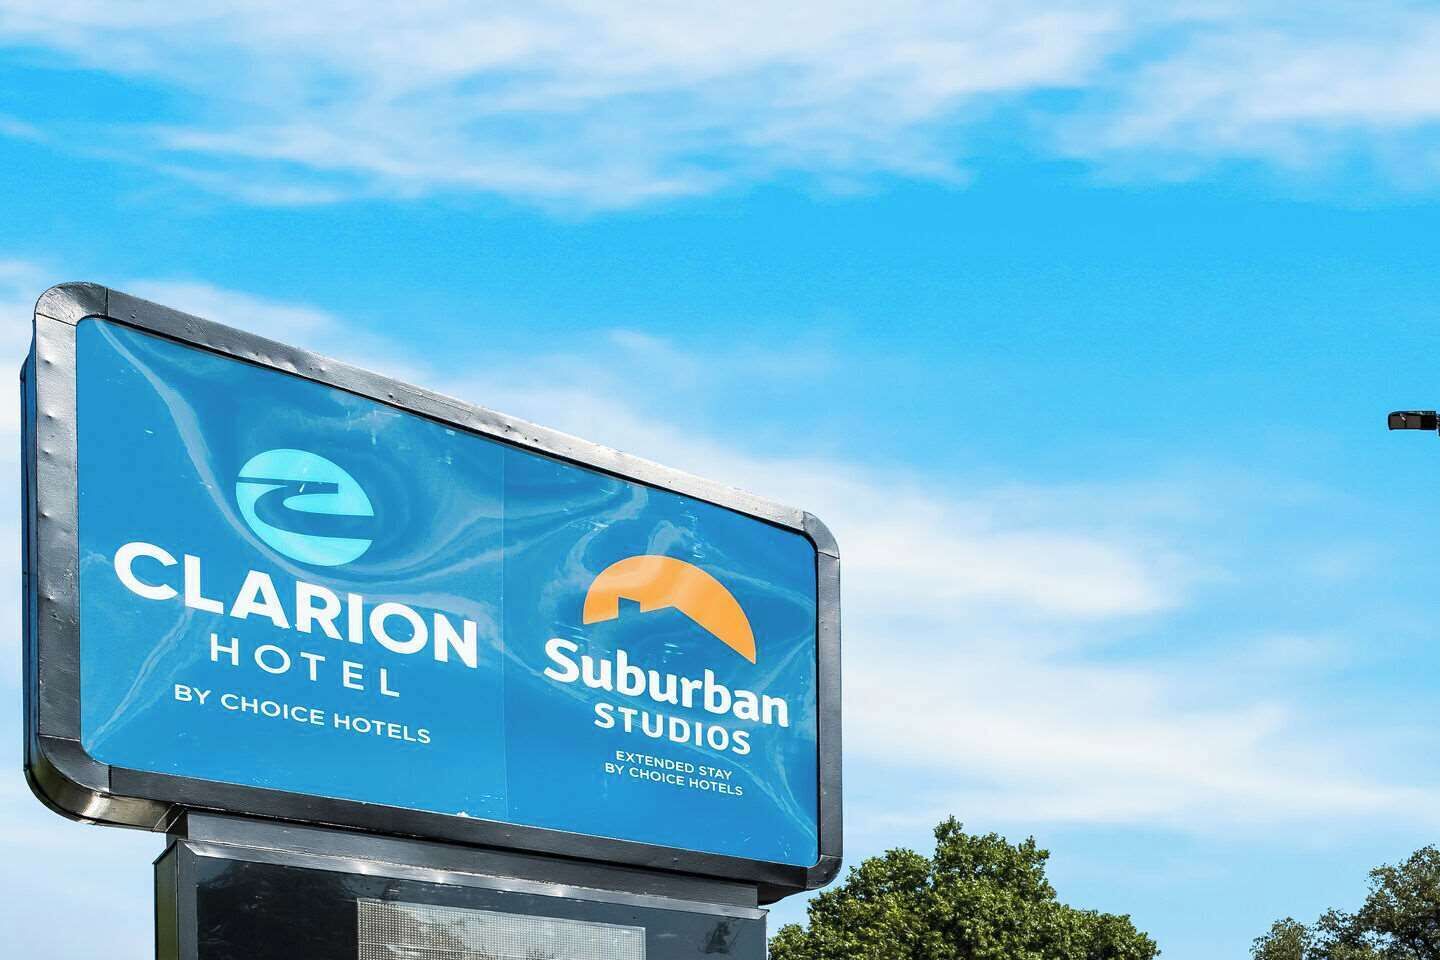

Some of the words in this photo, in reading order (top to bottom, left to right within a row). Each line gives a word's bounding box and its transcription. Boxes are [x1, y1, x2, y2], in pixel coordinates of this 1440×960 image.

[113, 541, 478, 669] CLARION
[210, 633, 400, 698] HOTEL
[543, 637, 790, 728] Suburban
[174, 684, 211, 705] BY
[220, 693, 325, 726] CHOICE
[333, 712, 431, 745] HOTELS
[593, 702, 751, 756] STUDIOS
[604, 762, 625, 776] BY
[628, 767, 686, 787] CHOICE
[688, 777, 744, 797] HOTELS
[615, 750, 695, 775] EXTENDED
[698, 765, 732, 781] STAY
